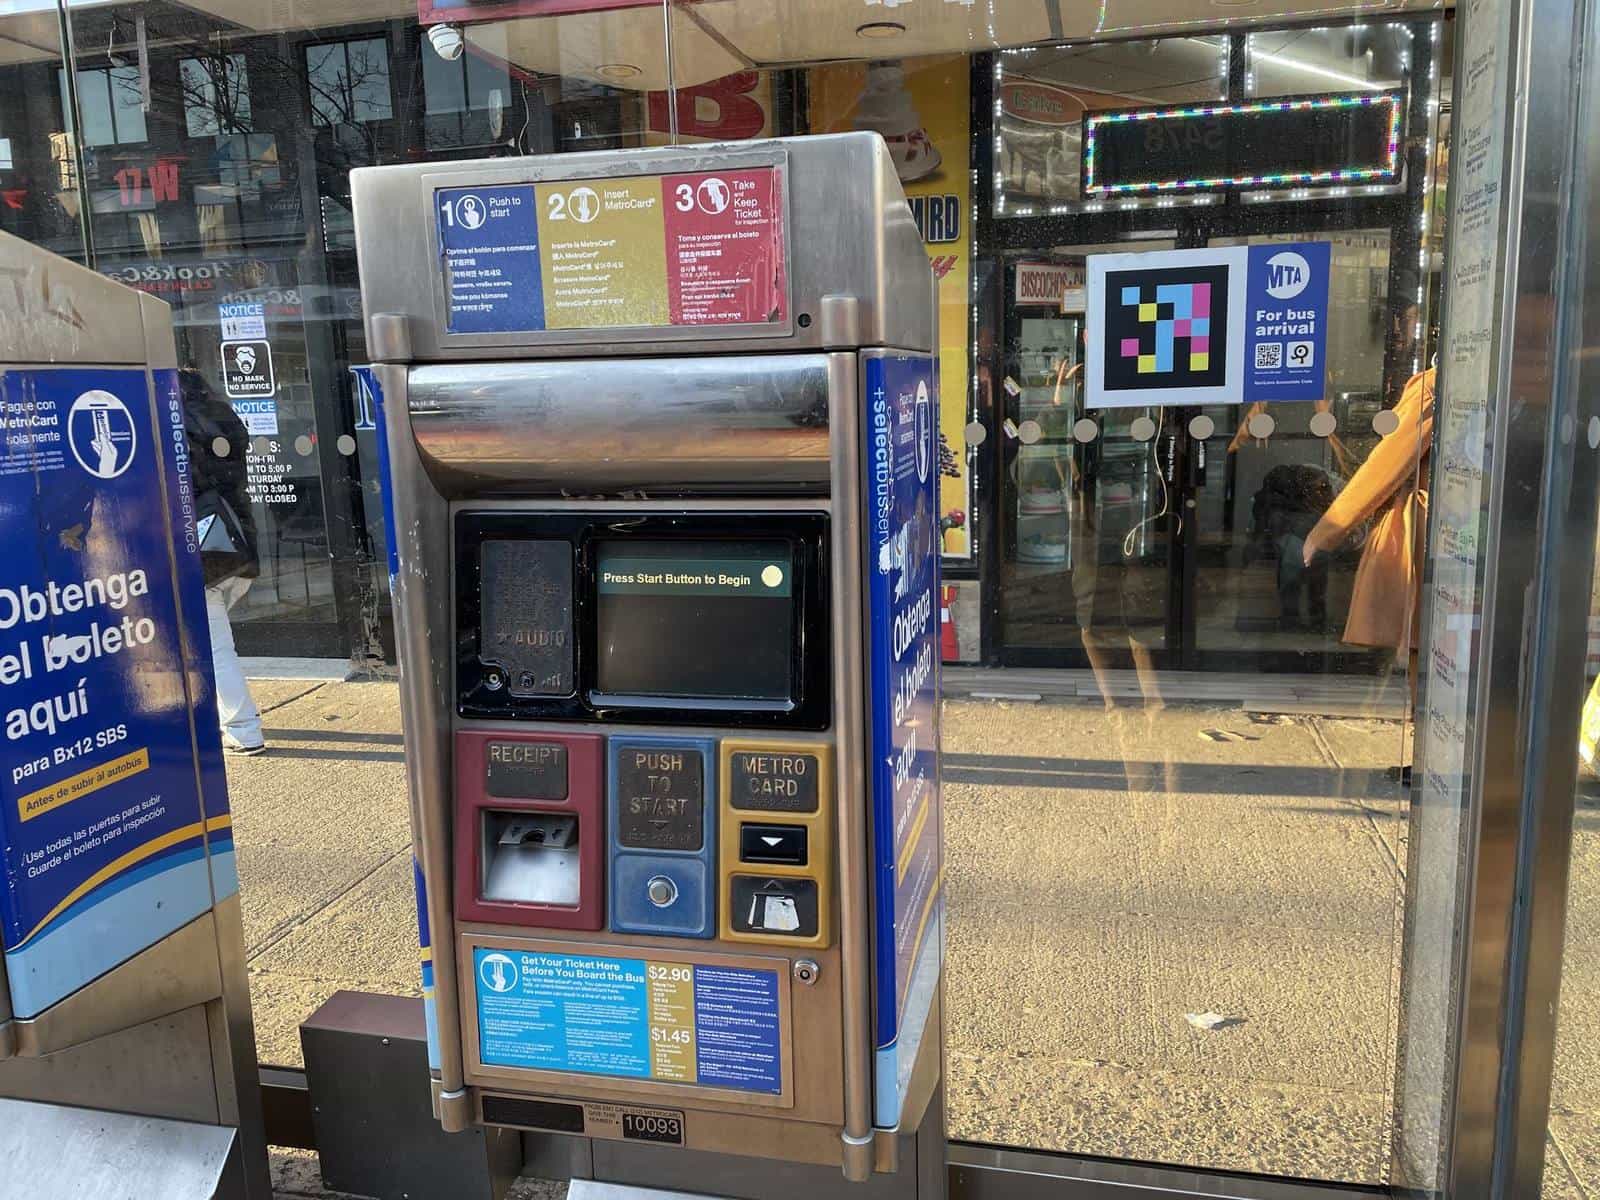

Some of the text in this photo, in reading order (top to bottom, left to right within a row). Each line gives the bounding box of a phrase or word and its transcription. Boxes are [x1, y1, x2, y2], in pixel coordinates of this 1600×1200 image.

[732, 180, 756, 190] Take
[489, 196, 521, 206] Push to
[604, 190, 630, 199] Insert
[675, 184, 694, 212] 3
[548, 192, 567, 220] 2
[734, 198, 758, 209] Keep
[441, 200, 454, 226] 1
[490, 208, 510, 218] start
[734, 208, 762, 219] Ticket
[1266, 264, 1302, 290] MTA
[220, 304, 265, 316] NOTICE
[1256, 308, 1316, 322] For bus
[1255, 320, 1315, 336] arrival
[36, 400, 56, 410] con
[232, 401, 276, 413] NOTICE
[255, 464, 267, 473] TO
[268, 464, 285, 473] 5:00
[247, 474, 282, 484] ATURDAY
[256, 485, 269, 493] TO
[270, 484, 287, 493] 3:00
[264, 494, 297, 503] CLOSED
[603, 572, 751, 588] Press Start Button to Begin
[0, 568, 149, 630] Obtenga
[894, 588, 930, 662] Obtenga
[0, 616, 156, 686] el boleto
[895, 640, 931, 728] el boleto
[4, 676, 88, 741] aquí
[12, 724, 128, 784] para Bx12 SBS
[490, 746, 561, 764] RECEIPT
[635, 753, 683, 771] PUSH
[742, 757, 806, 776] METRO
[24, 794, 55, 814] Antes
[56, 785, 70, 799] de
[70, 772, 94, 794] subir
[96, 768, 106, 784] al
[648, 776, 671, 792] TO
[750, 777, 798, 797] CARD
[630, 798, 688, 815] START
[25, 794, 162, 865] Use todas las puertas para subir
[28, 805, 166, 879] Guarde el boleto para inspección
[521, 956, 620, 971] Get Your Ticket Here
[522, 966, 645, 983] Before You Board the Bus
[648, 965, 691, 982] $2.90
[651, 1026, 690, 1044] $1.45
[625, 1115, 679, 1136] 10093
